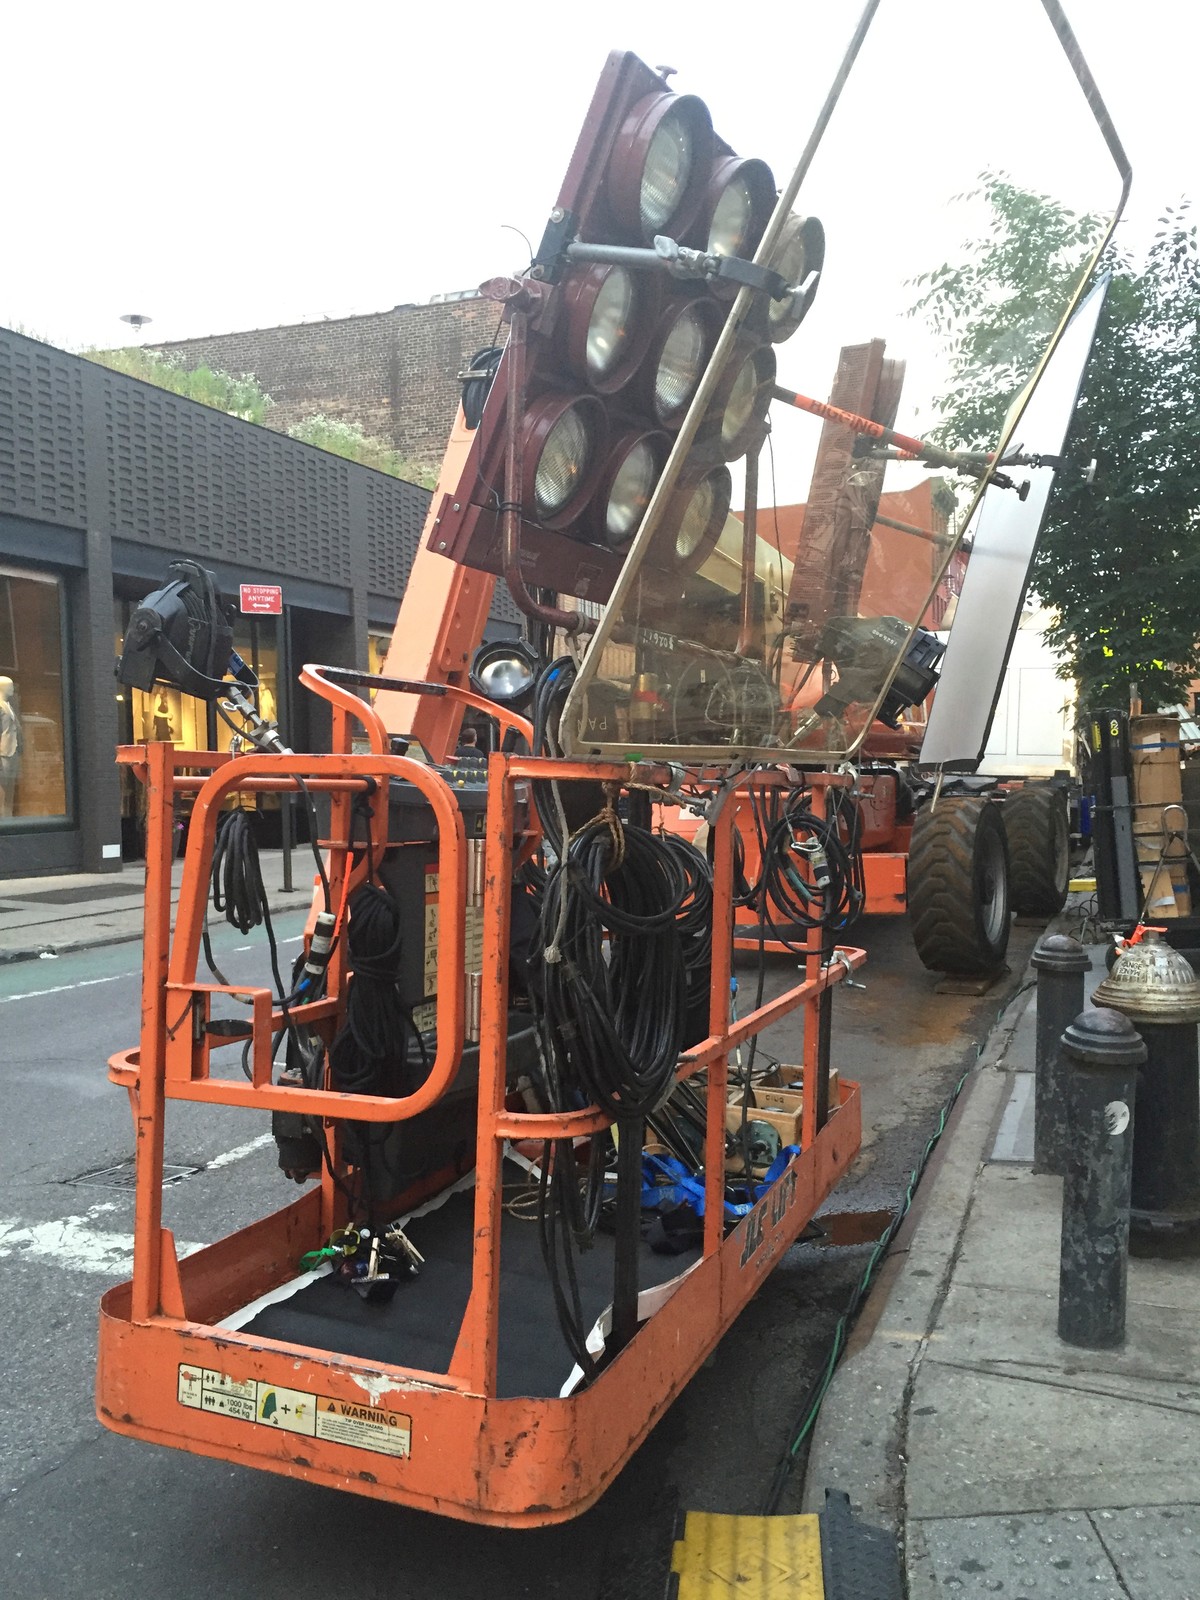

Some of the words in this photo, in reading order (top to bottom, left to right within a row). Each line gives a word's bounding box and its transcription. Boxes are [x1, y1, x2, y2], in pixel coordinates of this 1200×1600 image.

[248, 595, 275, 603] ANYTIME
[226, 1398, 242, 1408] 1000
[243, 1401, 253, 1411] lbs
[228, 1408, 241, 1416] 454
[241, 1410, 250, 1419] kg
[340, 1404, 398, 1427] WARNING
[365, 1422, 384, 1431] HAZARD
